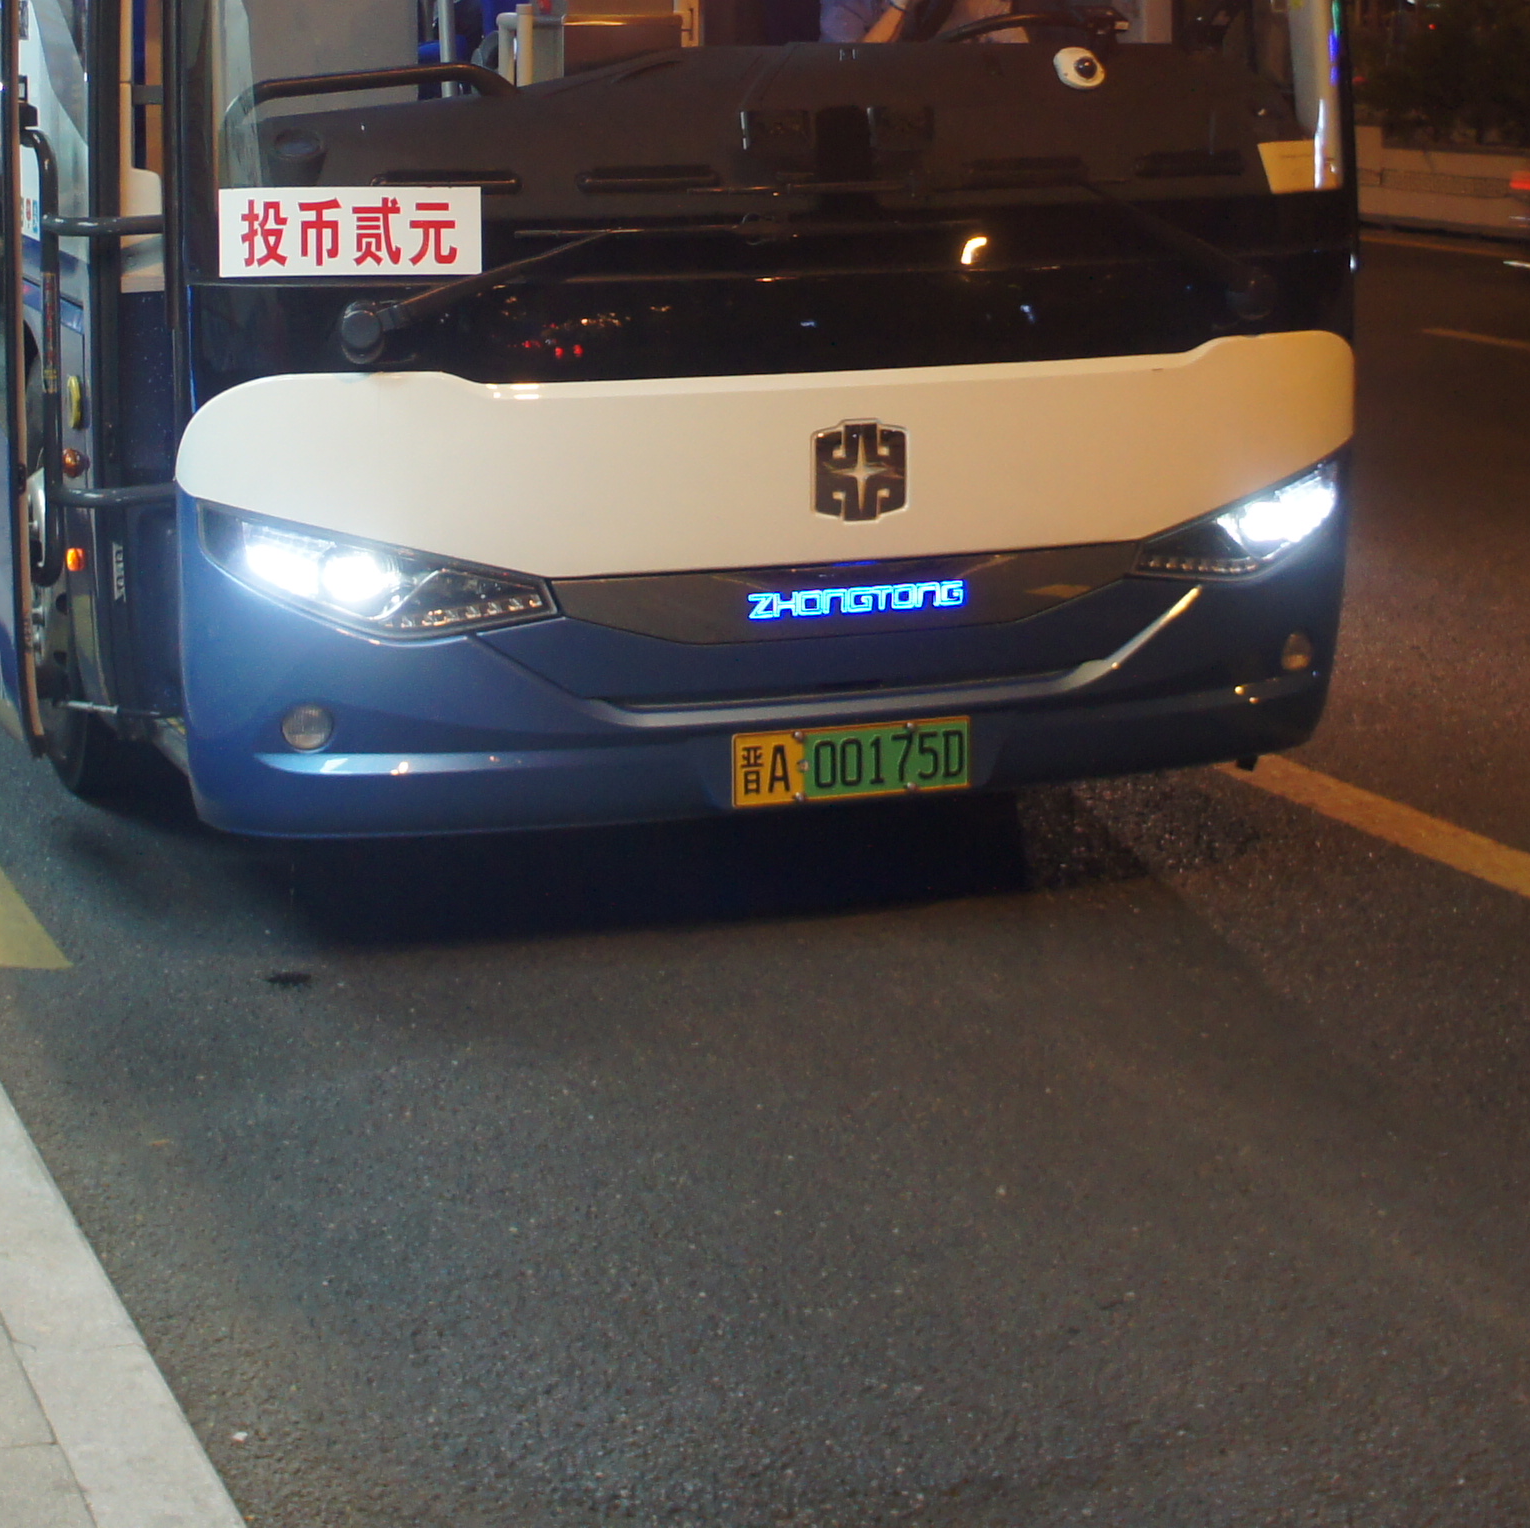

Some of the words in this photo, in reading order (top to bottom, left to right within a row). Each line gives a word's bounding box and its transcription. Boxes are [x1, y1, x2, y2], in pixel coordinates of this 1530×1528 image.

[239, 197, 459, 268] 投币贰元
[747, 578, 965, 622] ZHONGTONG
